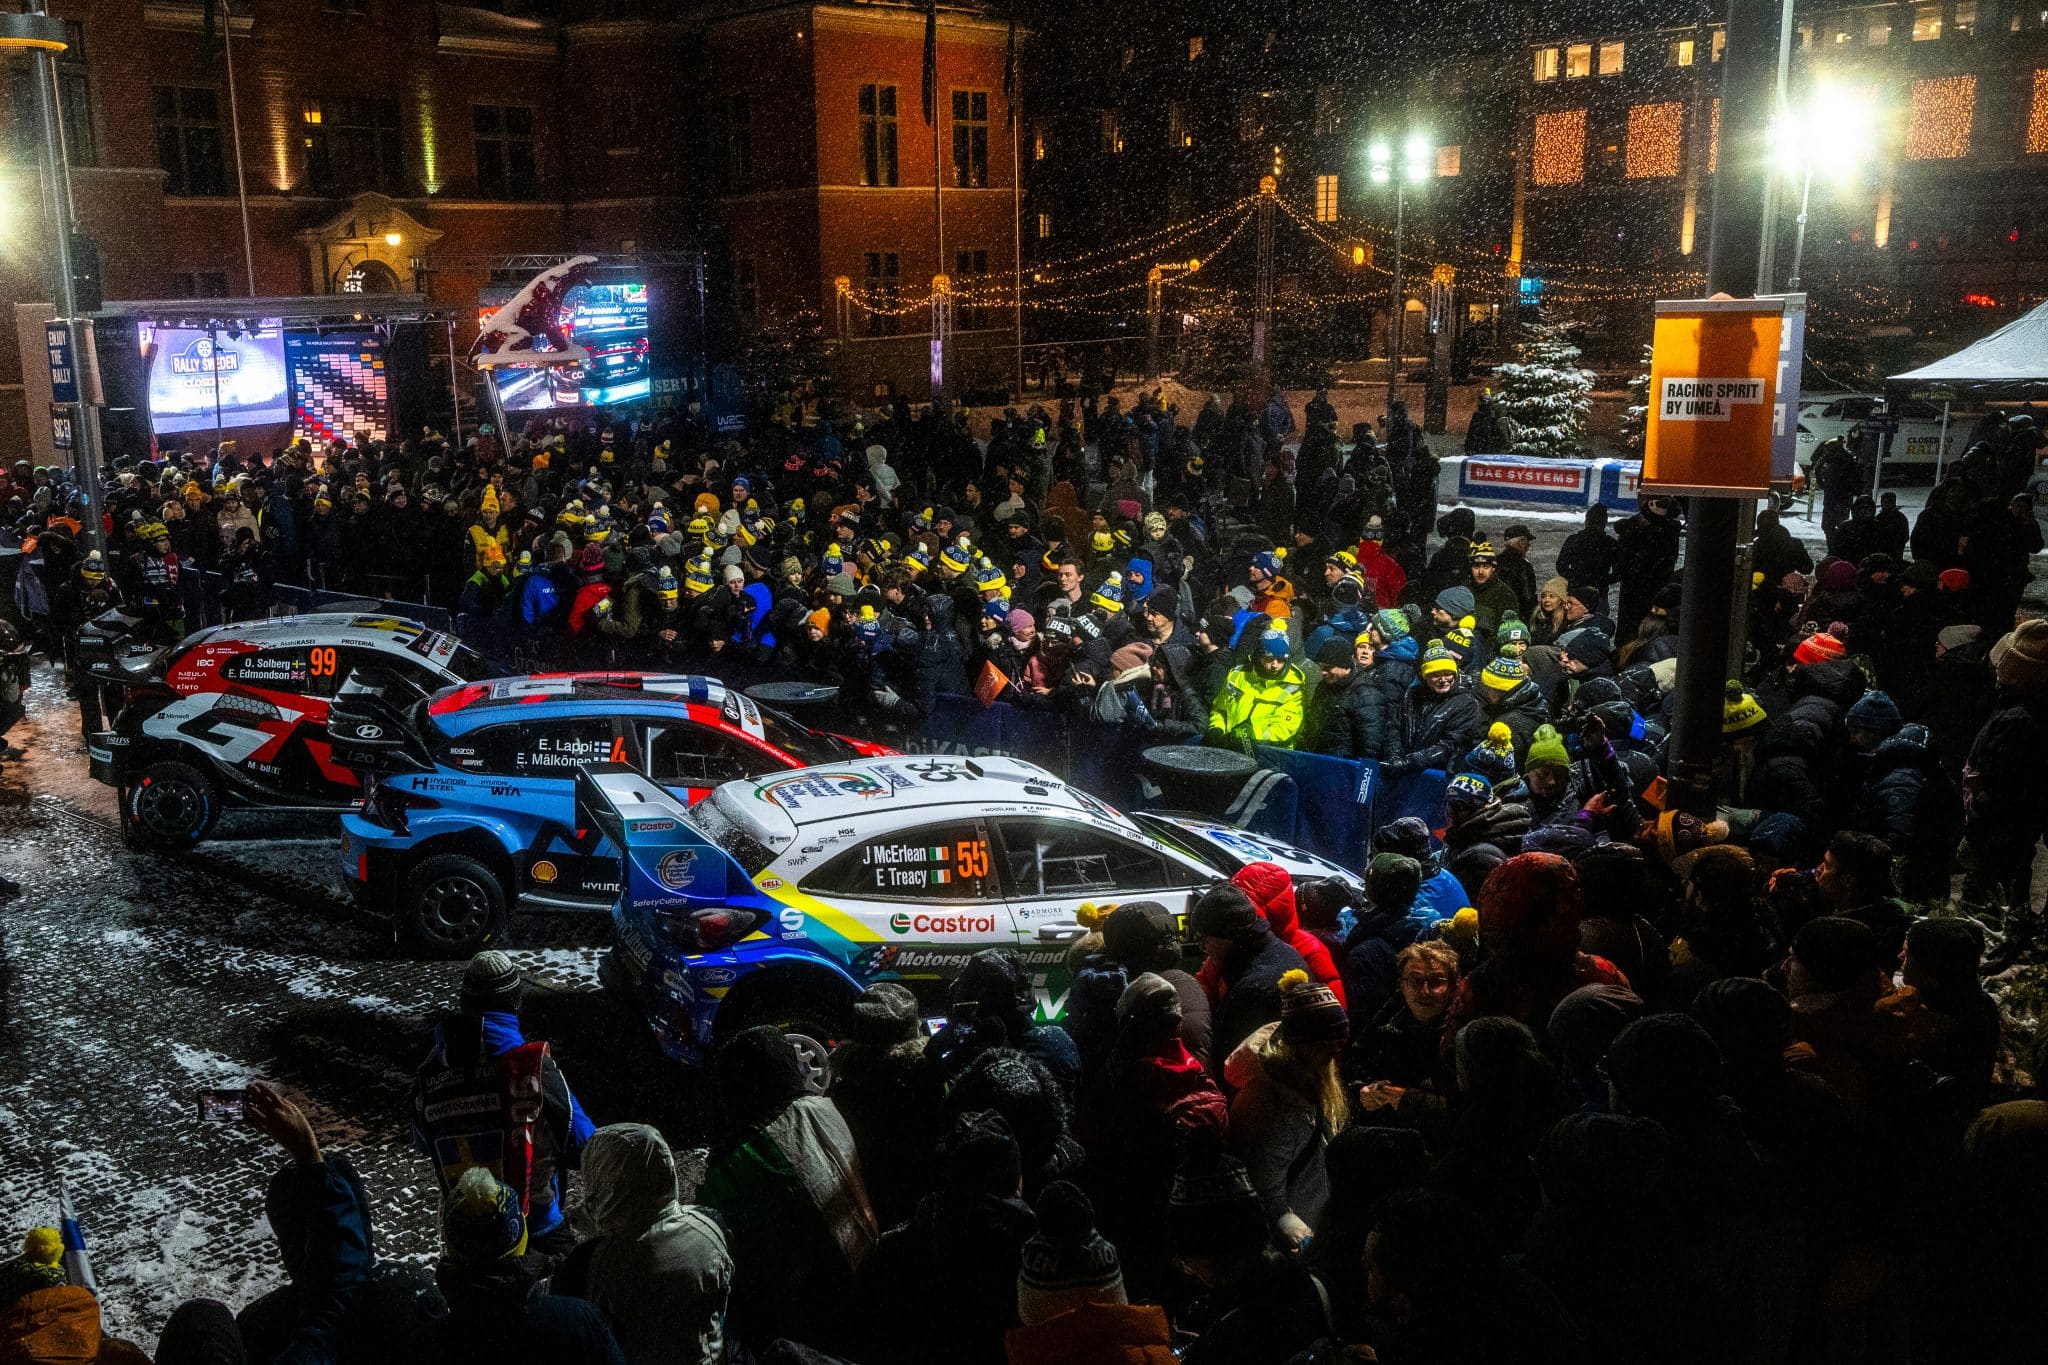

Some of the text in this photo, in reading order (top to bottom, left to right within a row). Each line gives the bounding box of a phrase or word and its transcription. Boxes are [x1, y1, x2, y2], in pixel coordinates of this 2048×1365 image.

[48, 331, 66, 347] ENJOY
[50, 350, 62, 365] THE
[174, 354, 237, 373] RALLY SWEDEN
[53, 368, 70, 383] RALLY
[1667, 384, 1759, 398] RACING SPIRIT
[1666, 399, 1725, 415] BY UMEÅ.
[1476, 468, 1575, 484] BAE SYSTEMS
[131, 642, 152, 652] Stilo
[341, 638, 375, 647] PROTERIAL
[245, 659, 291, 670] O. Solberg
[310, 647, 336, 676] 99
[228, 669, 290, 680] E. Edmondson
[538, 738, 593, 755] E. Lappi
[610, 736, 628, 763] 4
[517, 753, 528, 765] E.
[430, 778, 467, 786] HYUNDAI
[639, 822, 675, 832] Castrol
[838, 829, 856, 837] NGK
[863, 844, 927, 865] J McErlean
[957, 840, 989, 878] 55
[761, 880, 781, 888] BELL
[876, 867, 927, 889] E Treacy
[633, 897, 688, 907] SafetyCulture
[914, 913, 995, 933] Castrol
[703, 970, 730, 981] Ford
[428, 1098, 498, 1118] PHOTOGRAPHER
